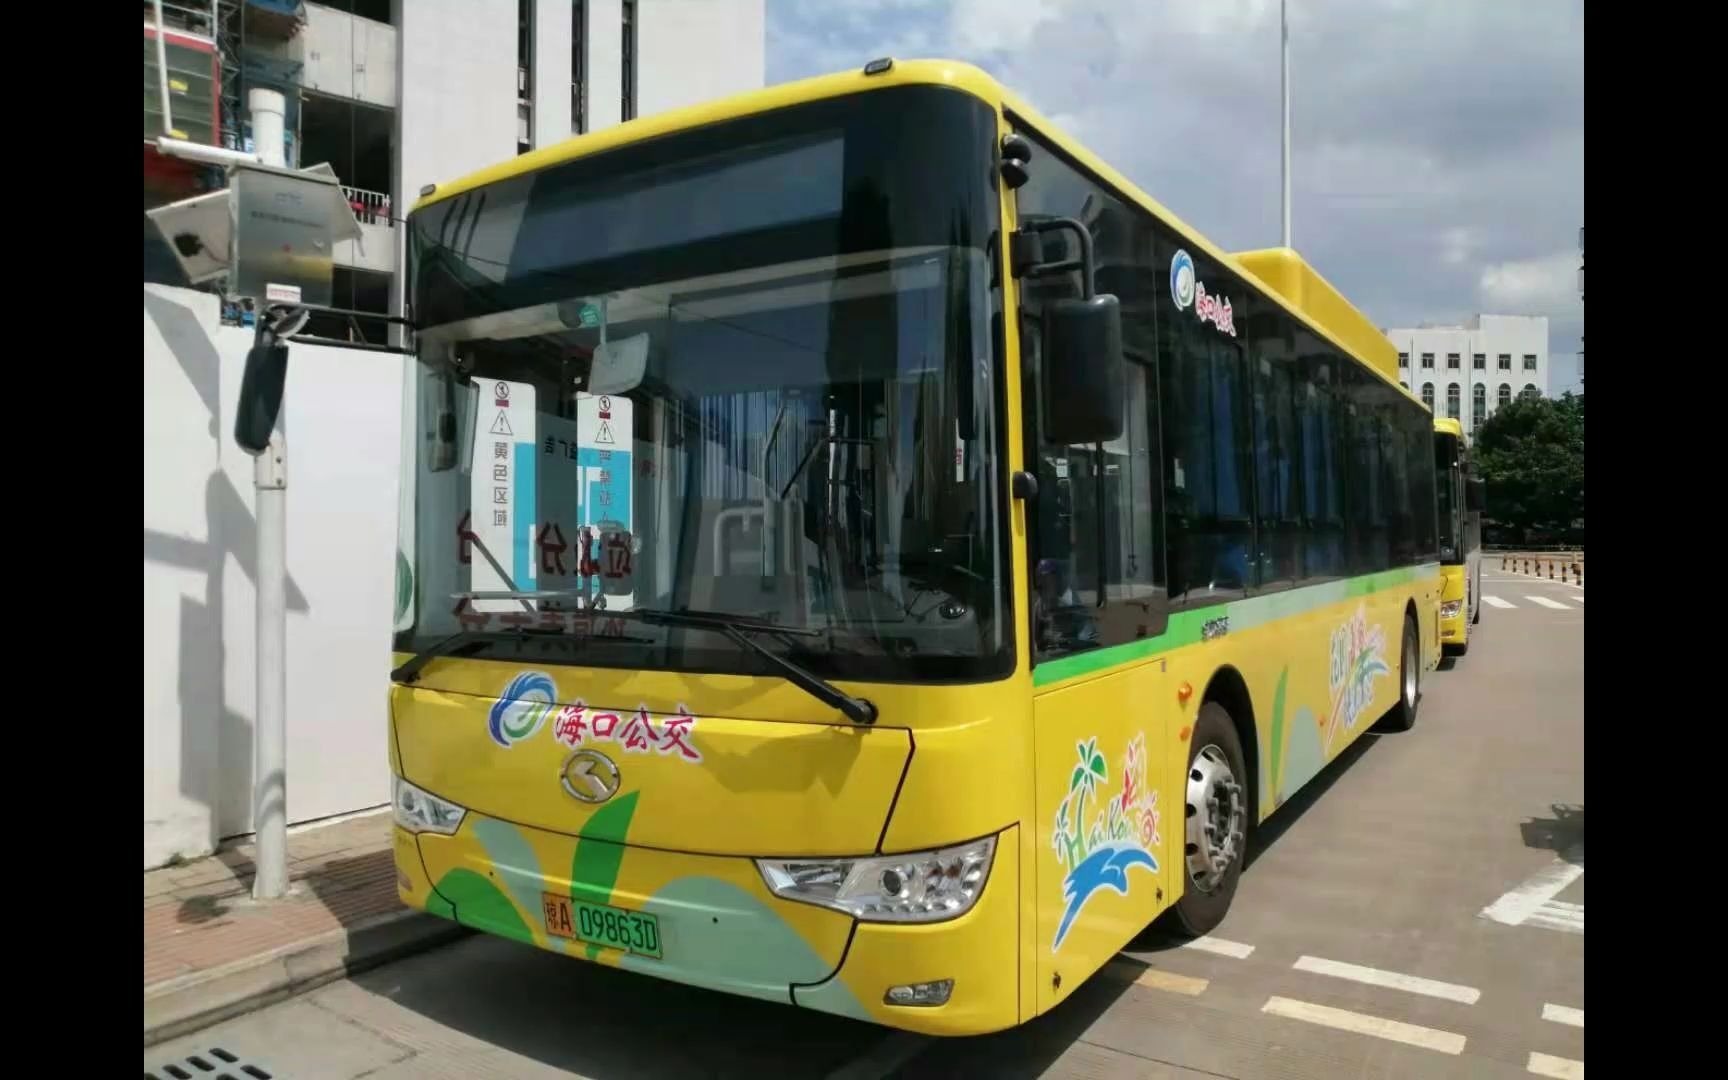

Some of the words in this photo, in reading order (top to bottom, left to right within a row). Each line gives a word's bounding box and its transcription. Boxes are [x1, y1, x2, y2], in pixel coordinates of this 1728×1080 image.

[555, 701, 700, 759] 海口公交
[579, 906, 657, 951] 09863D
